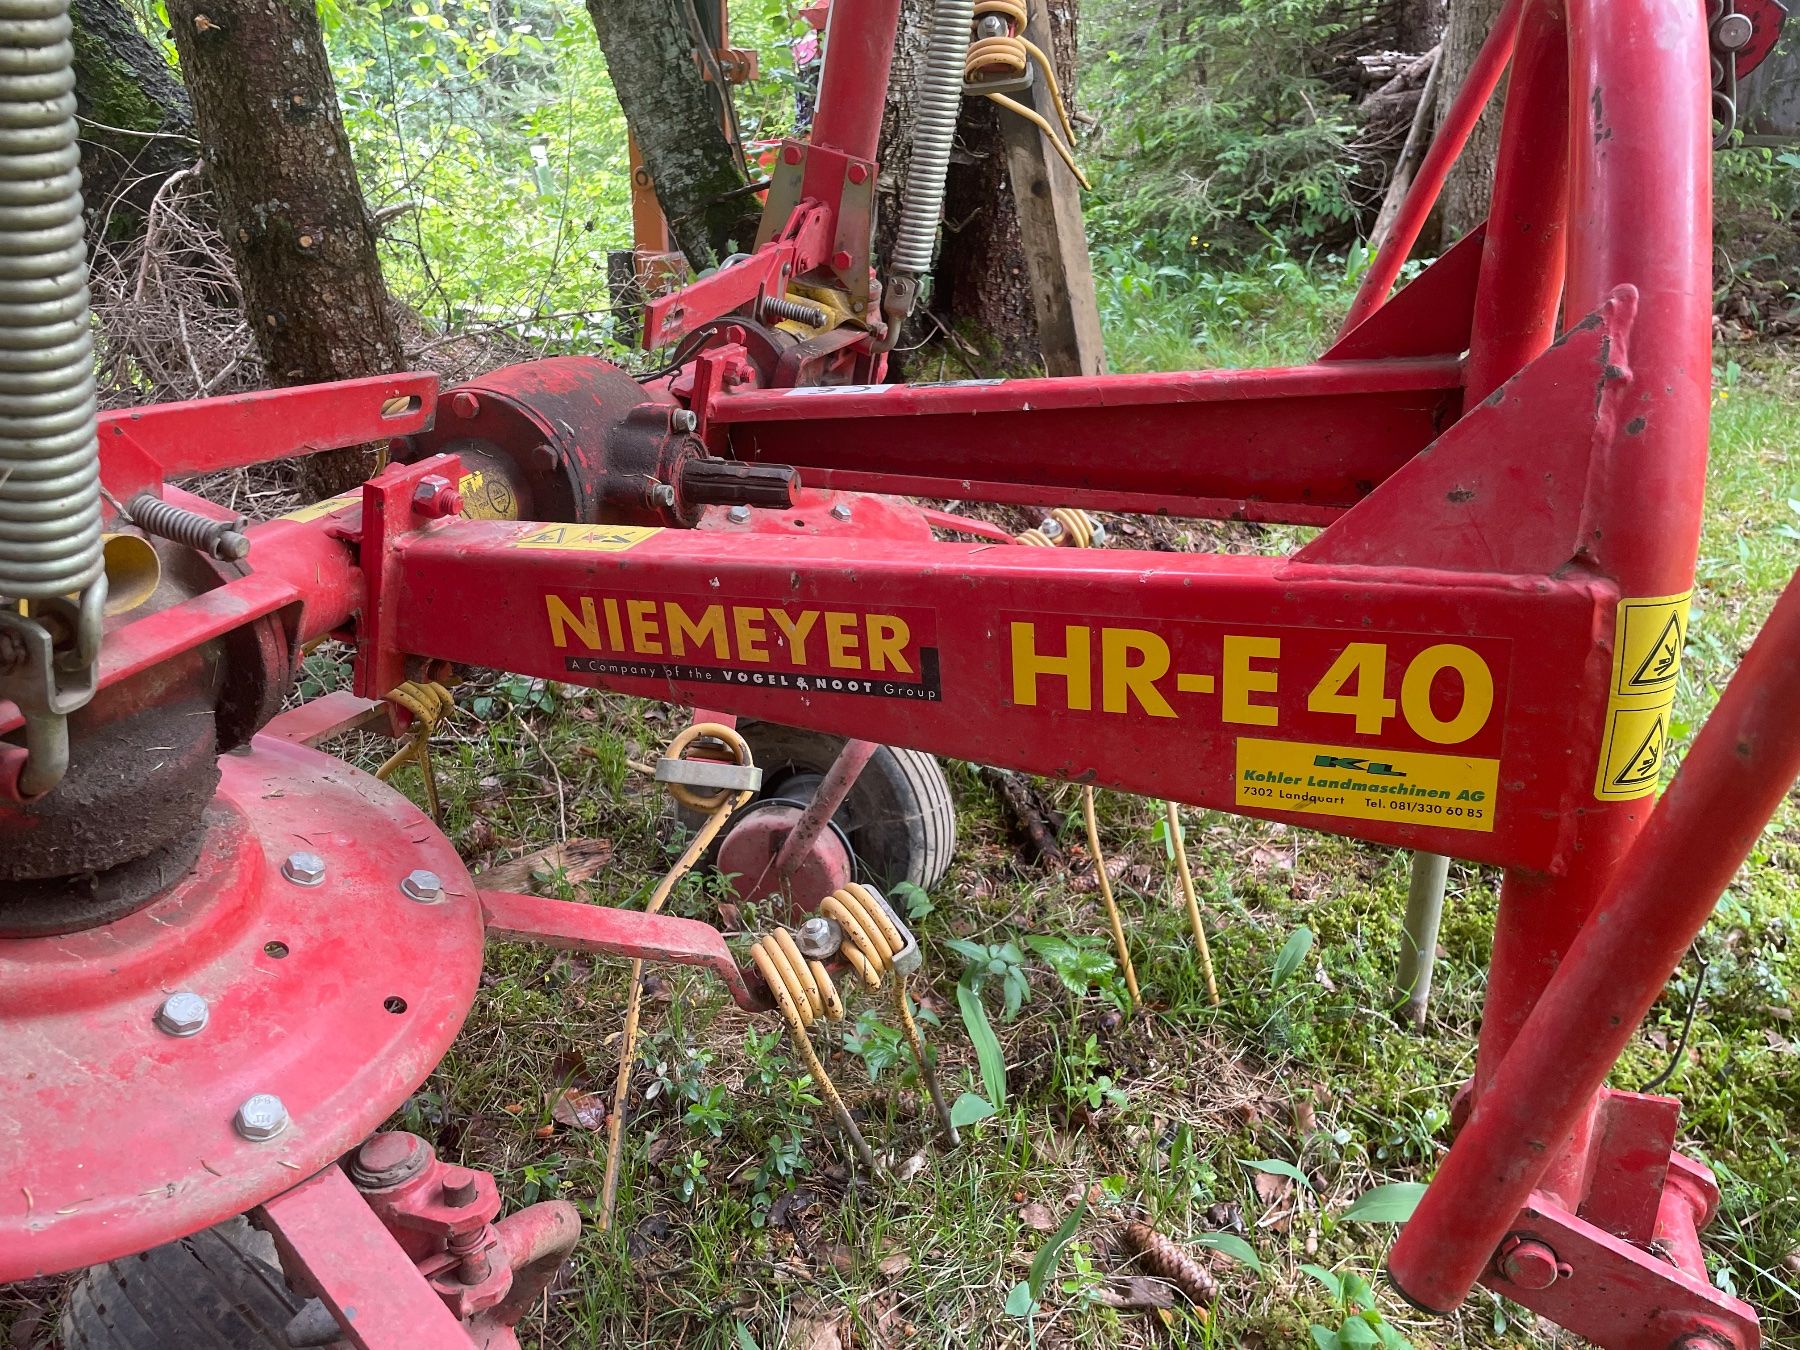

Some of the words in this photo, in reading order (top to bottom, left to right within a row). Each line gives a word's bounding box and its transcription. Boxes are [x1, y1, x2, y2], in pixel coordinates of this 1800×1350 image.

[545, 594, 914, 674] NIEMEYER
[572, 660, 580, 669] A
[589, 661, 656, 678] Company
[666, 665, 680, 676] of
[689, 668, 712, 680] the
[722, 670, 789, 686] VOGEL
[796, 676, 808, 688] &
[816, 678, 873, 693] NOOT
[884, 683, 936, 700] Group
[1010, 621, 1281, 727] HR-E
[1307, 642, 1494, 745] 40
[1313, 754, 1407, 777] KL
[1243, 769, 1302, 785] Kohler
[1307, 775, 1451, 800] Landmaschinen
[1456, 789, 1486, 802] AG
[1243, 786, 1273, 798] 7302
[1279, 789, 1345, 804] Landquart
[1364, 797, 1386, 809] Tel.
[1389, 800, 1442, 814] 081/330
[1446, 806, 1464, 817] 60
[1467, 808, 1483, 819] 85
